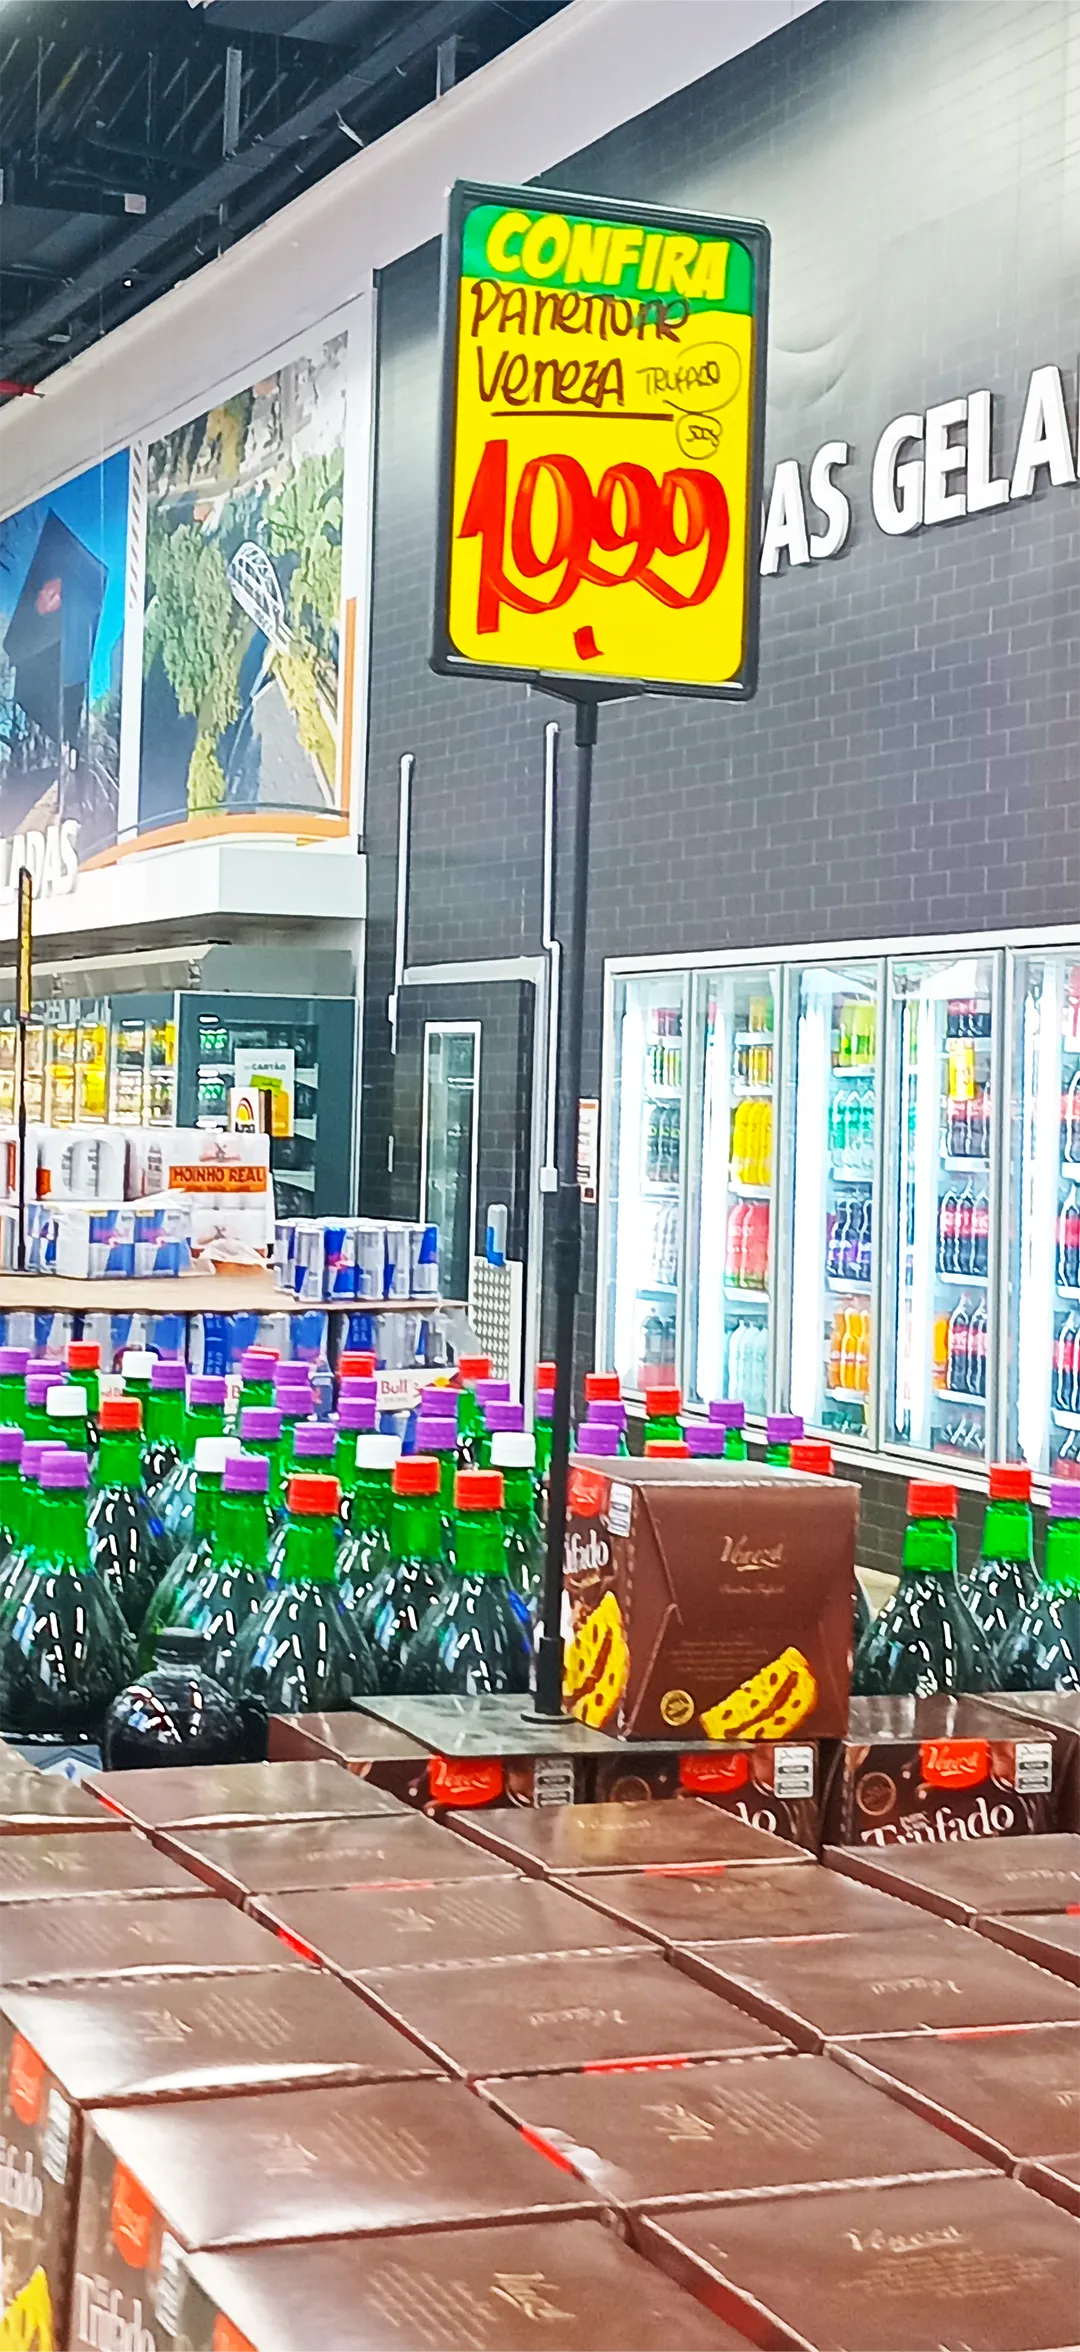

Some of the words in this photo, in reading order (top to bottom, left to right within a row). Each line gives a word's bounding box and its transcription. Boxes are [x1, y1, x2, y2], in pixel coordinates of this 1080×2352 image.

[486, 211, 730, 300] CONFIRA
[760, 440, 851, 576] AS
[872, 364, 1080, 536] GELA
[173, 1167, 225, 1182] MOINHO
[229, 1167, 264, 1182] REAL
[381, 1379, 408, 1395] Bull
